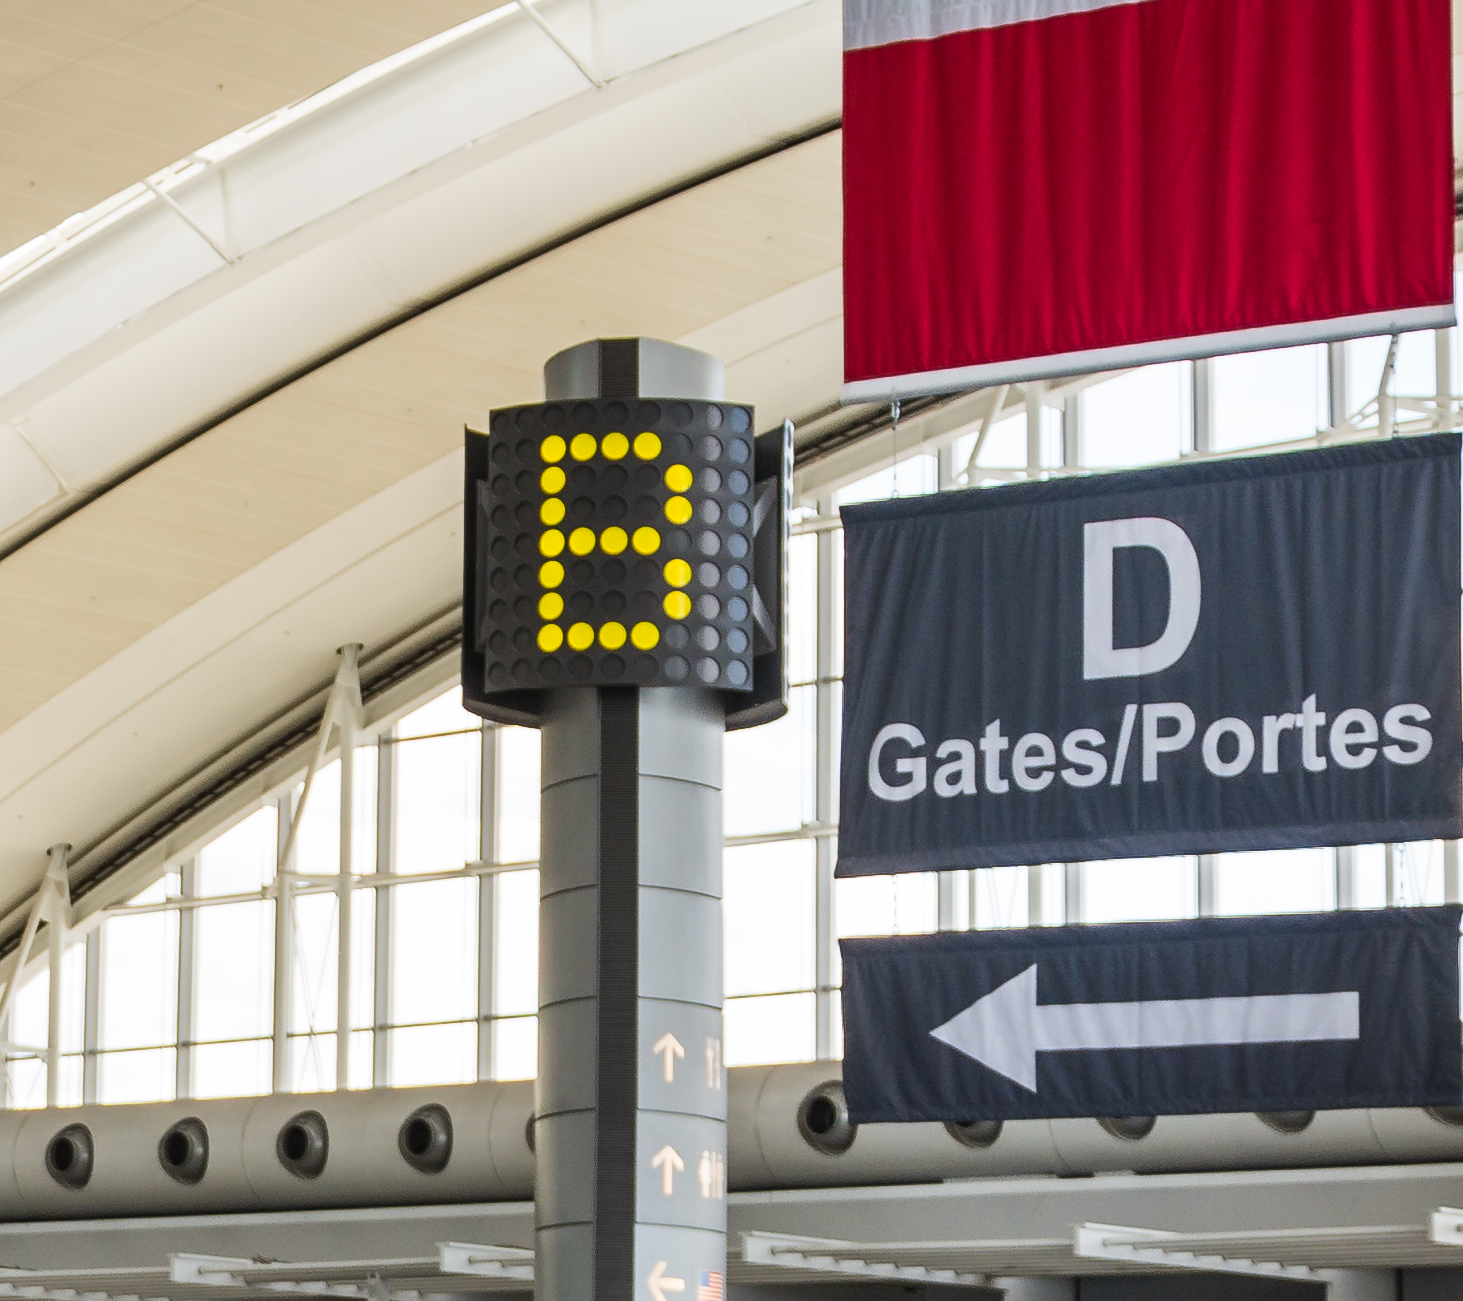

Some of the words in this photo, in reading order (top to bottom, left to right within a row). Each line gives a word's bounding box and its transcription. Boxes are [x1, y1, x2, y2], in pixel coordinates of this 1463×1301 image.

[538, 430, 695, 654] B
[1083, 516, 1202, 681] D
[868, 694, 1434, 802] Gates/Portes
